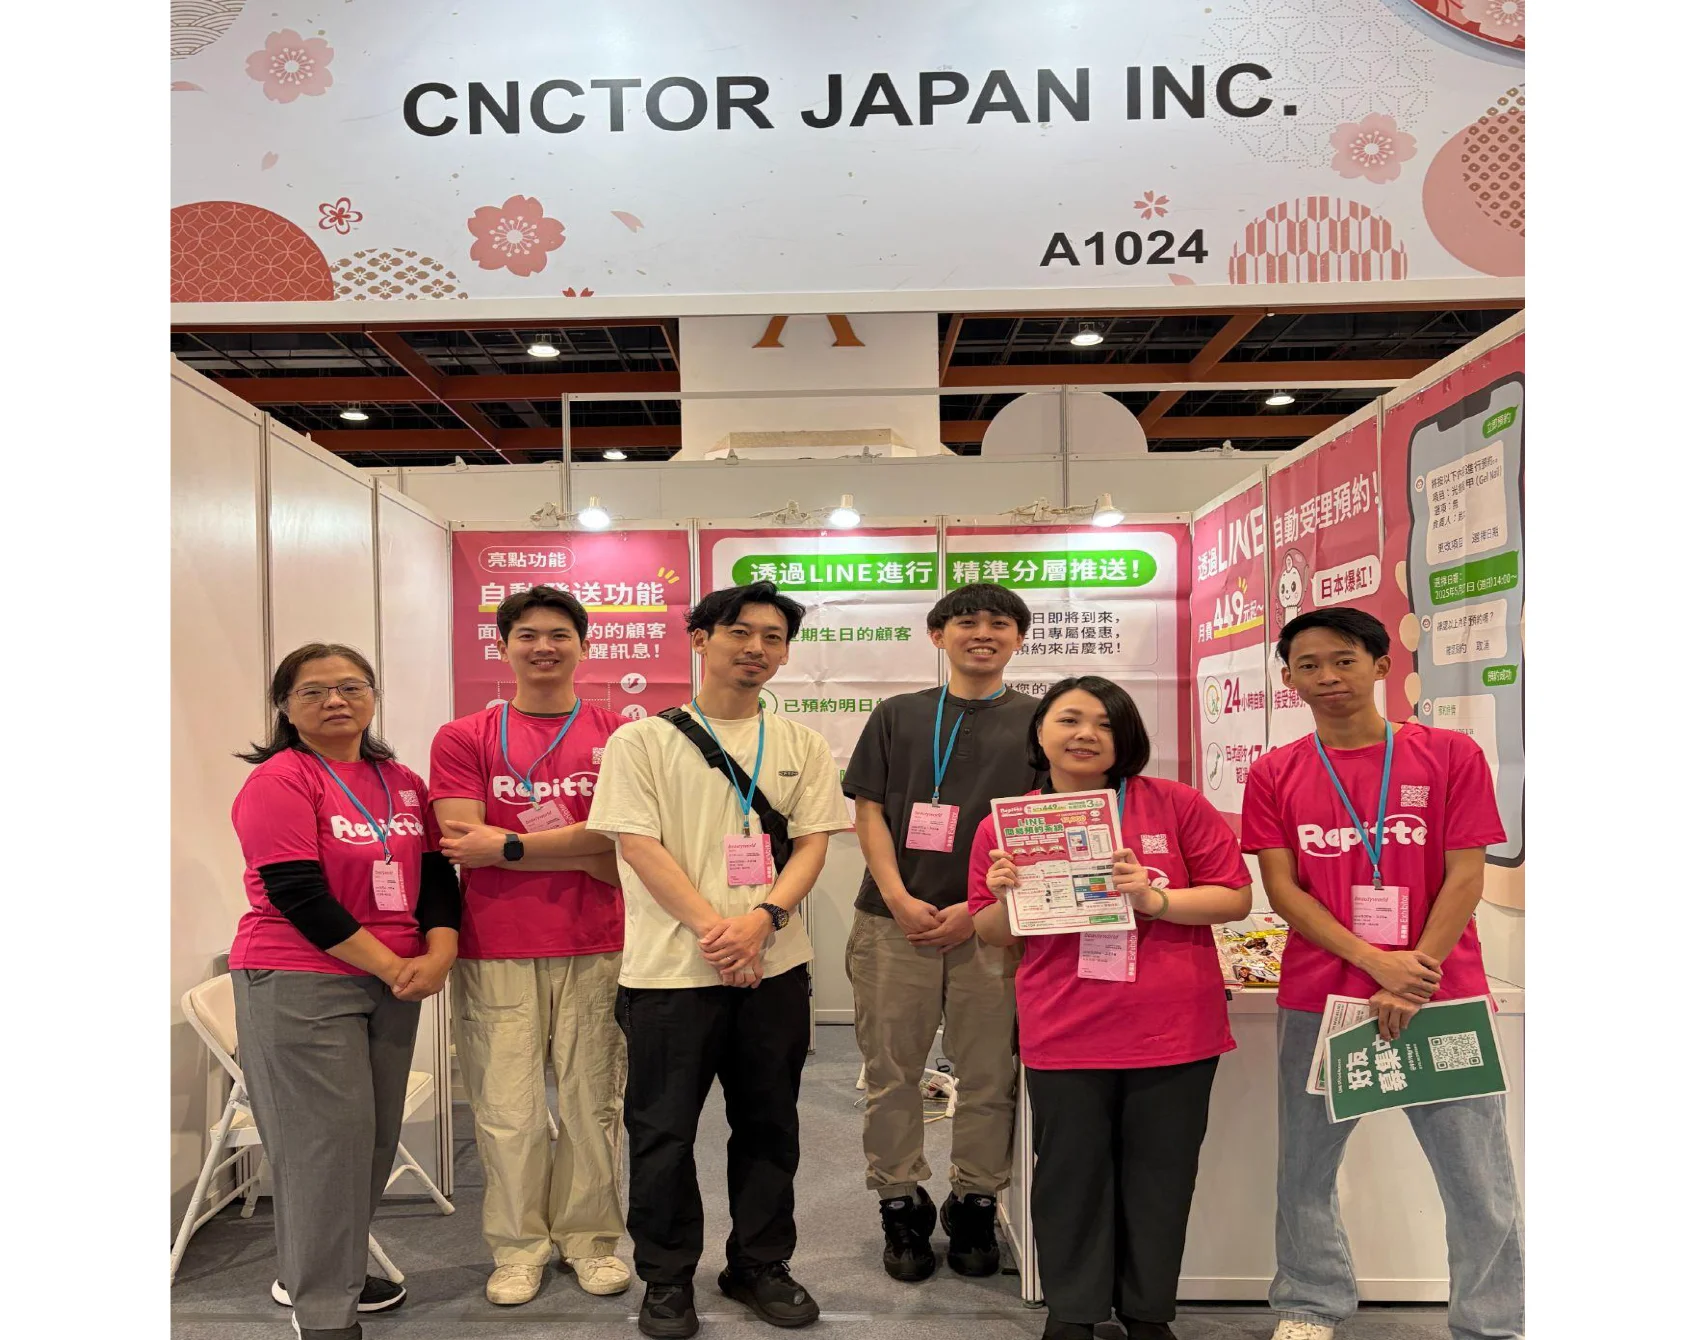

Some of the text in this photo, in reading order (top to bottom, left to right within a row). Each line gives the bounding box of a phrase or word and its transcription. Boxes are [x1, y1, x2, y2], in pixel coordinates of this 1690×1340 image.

[403, 62, 1298, 137] CNCTOR JAPAN INC.
[1040, 228, 1209, 267] A1024
[488, 552, 567, 568] 亮點功能
[750, 559, 1141, 585] 透過LINE進行 精準分層推送!
[1321, 566, 1373, 599] 日本爆紅!
[784, 698, 882, 713] 已預約明日
[493, 776, 598, 802] Repitt
[1346, 1047, 1373, 1091] 好友
